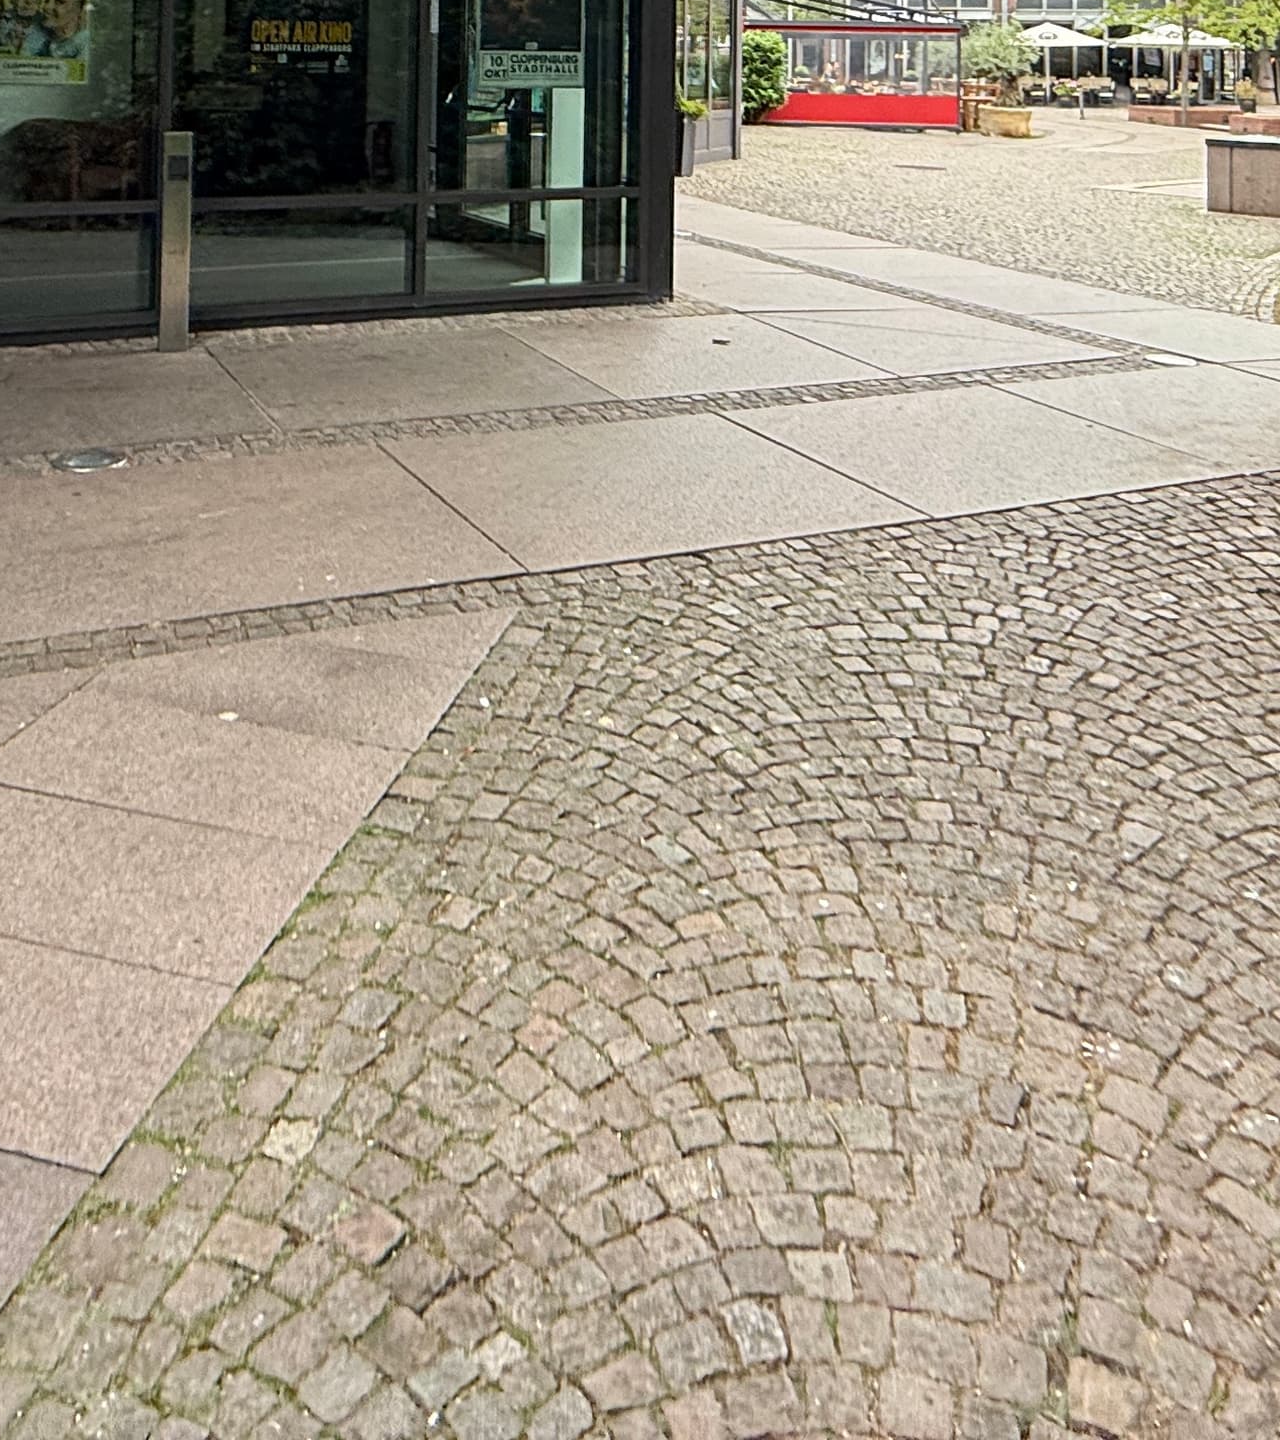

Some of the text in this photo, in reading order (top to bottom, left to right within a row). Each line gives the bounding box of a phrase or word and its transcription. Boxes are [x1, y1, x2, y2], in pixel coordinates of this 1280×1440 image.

[251, 20, 353, 43] OPEN AIR KINO
[510, 54, 579, 64] CLOPPENBURG
[484, 68, 506, 78] OKT
[510, 64, 578, 74] STADTHALLE
